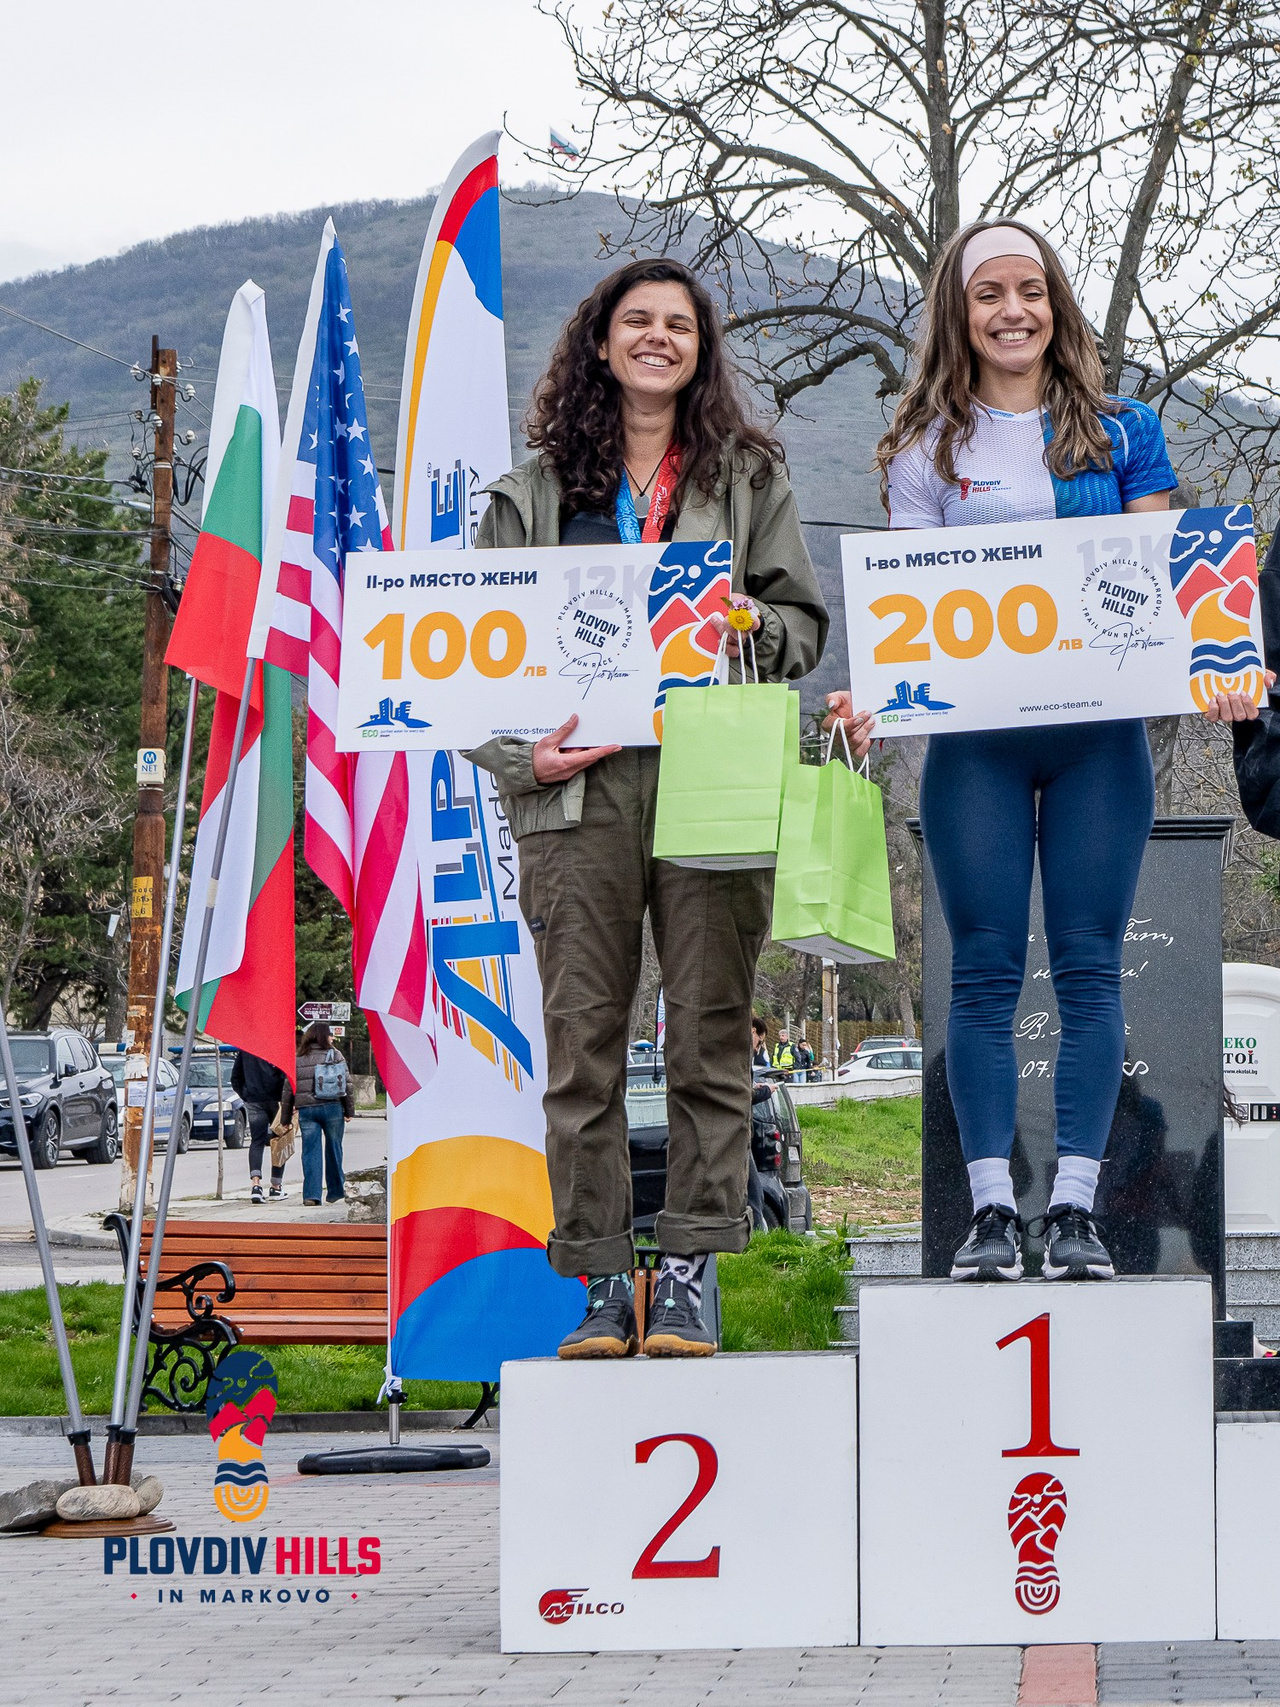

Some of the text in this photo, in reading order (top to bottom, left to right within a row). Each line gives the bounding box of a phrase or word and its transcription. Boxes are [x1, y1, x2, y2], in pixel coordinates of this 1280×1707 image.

[905, 548, 976, 568] МЯСТО
[981, 543, 1043, 564] ЖЕНИ
[1077, 533, 1171, 583] 12K
[410, 572, 476, 588] МЯСТО
[480, 570, 538, 586] ЖЕНИ
[563, 564, 657, 610] 12K
[1081, 559, 1162, 617] PLOVDIV HILLS IN MARKOVO
[1097, 580, 1149, 606] PLOVDIV
[557, 589, 632, 648] PLOVDIV HILLS IN MARKOVO
[1082, 607, 1099, 629] TRAIL
[1101, 597, 1135, 618] HILLS
[573, 609, 620, 637] PLOVDIV
[867, 584, 1083, 665] 200 лв
[363, 609, 547, 680] 100 лв
[556, 635, 571, 658] TRAIL
[574, 626, 606, 648] HILLS
[881, 714, 899, 723] ECO
[1019, 699, 1103, 713] www.eco-steam.eu
[362, 729, 378, 738] ECO
[491, 726, 557, 735] www.eco-steam
[996, 1312, 1080, 1458] 1
[633, 1433, 721, 1580] 2
[541, 1602, 624, 1619] MILCO
